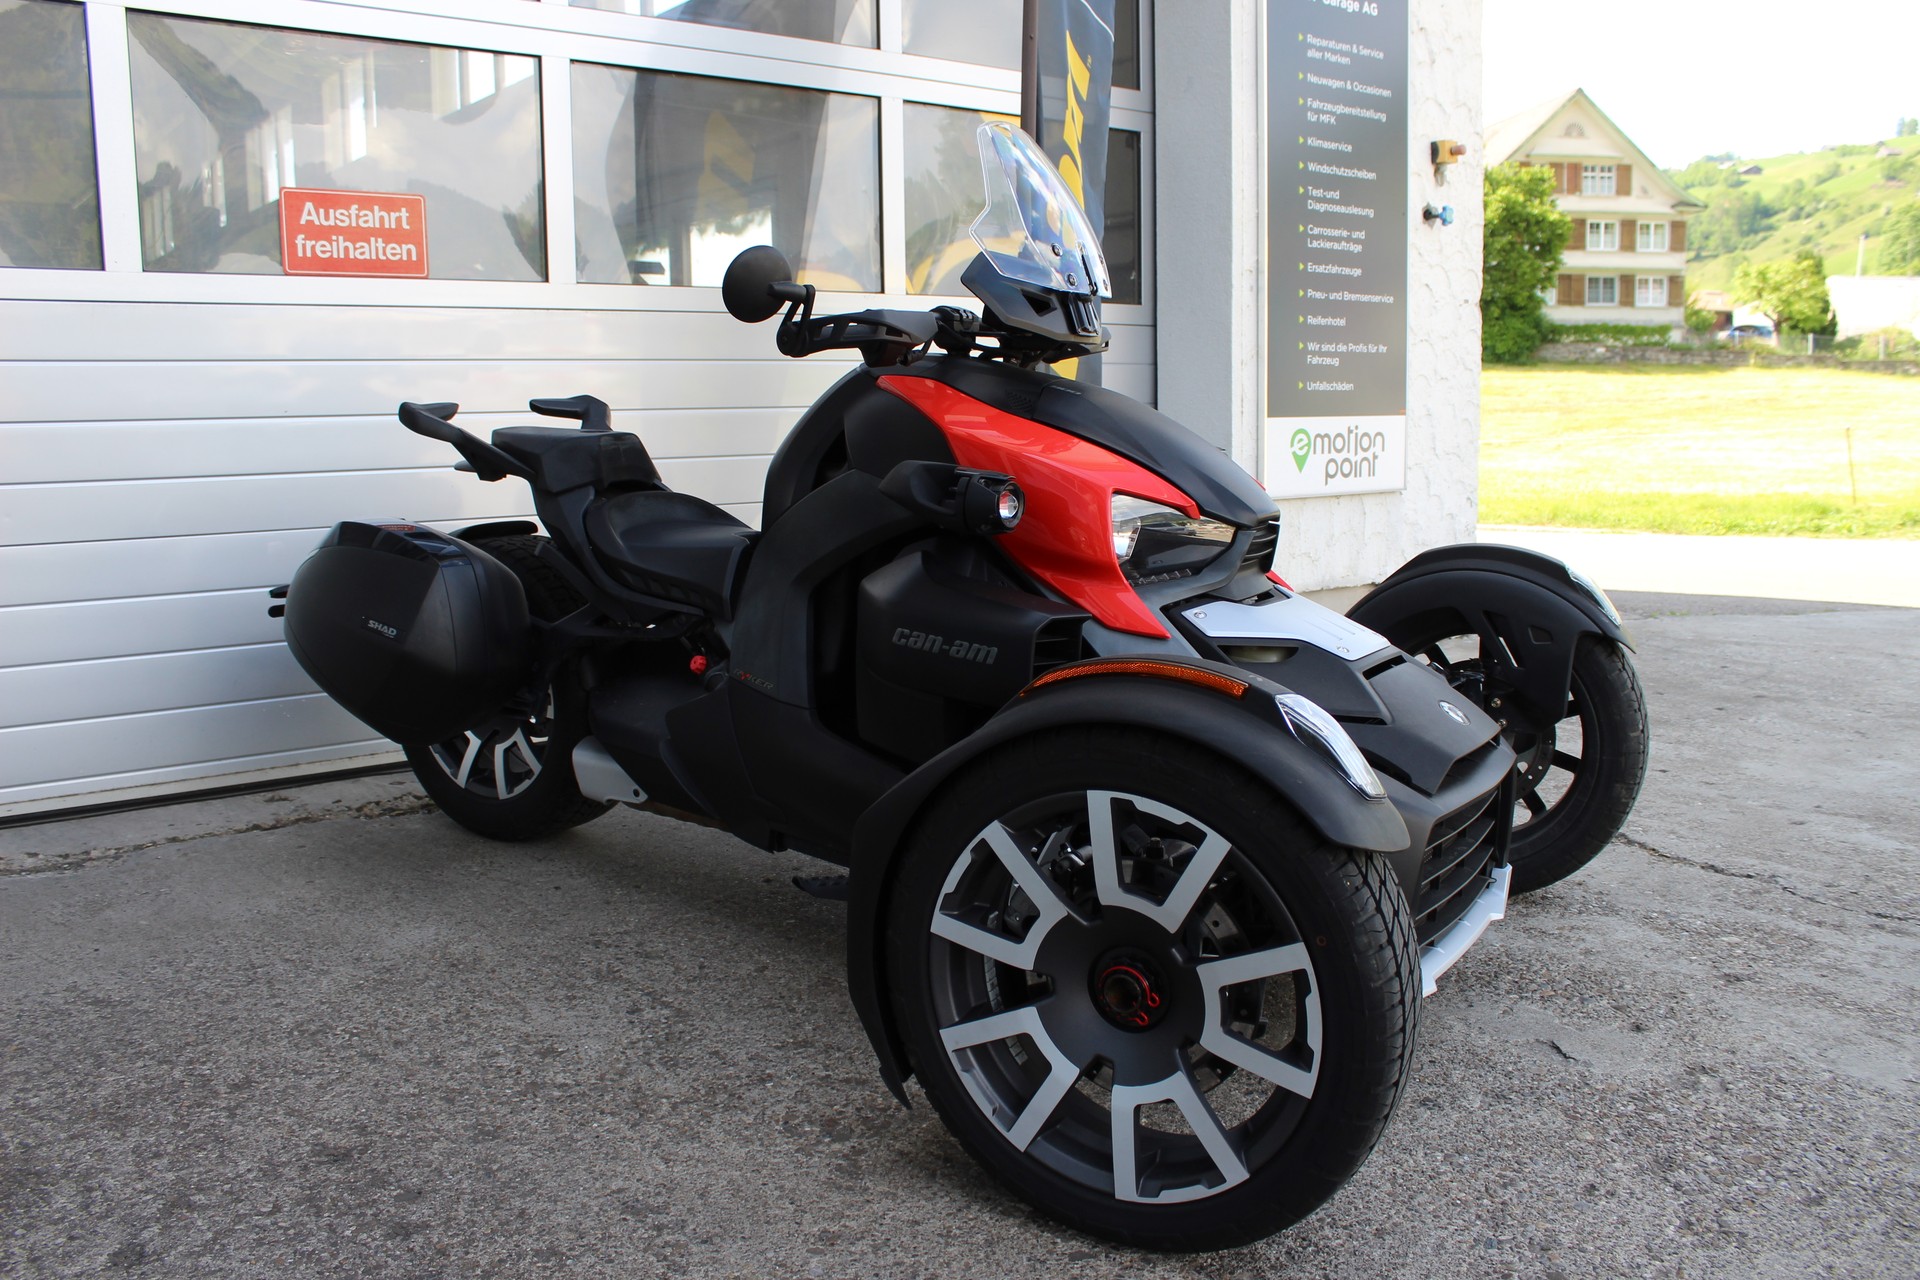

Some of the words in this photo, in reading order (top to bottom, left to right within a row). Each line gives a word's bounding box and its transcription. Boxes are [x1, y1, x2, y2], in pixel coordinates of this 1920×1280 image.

[1362, 1, 1378, 16] AG
[1307, 33, 1351, 53] Reparaturen
[1352, 44, 1358, 53] &
[1359, 45, 1384, 59] Service
[1307, 48, 1323, 59] aller
[1324, 51, 1351, 65] Marken
[1307, 73, 1346, 89] Neuwagen
[1346, 80, 1352, 90] &
[1353, 81, 1392, 98] Occasionen
[1307, 98, 1387, 122] Fahrzeugbereitstellung
[1307, 111, 1318, 122] für
[1319, 114, 1336, 125] MFK
[1307, 137, 1352, 152] Klimaservice
[1307, 161, 1377, 180] Windschutzscheiben
[300, 201, 410, 229] Ausfahrt
[1307, 200, 1375, 218] Diagnoseauslesung
[1307, 225, 1350, 238] Carrosserie-
[1352, 230, 1365, 239] und
[295, 234, 417, 261] freihalten
[1307, 238, 1363, 253] Lackieraufträge
[1307, 263, 1362, 277] Ersatzfahrzeuge
[1307, 289, 1328, 299] Pneu-
[1329, 291, 1343, 301] und
[1343, 291, 1394, 304] Bremsenservice
[1307, 315, 1346, 326] Reifenhotel
[1307, 342, 1319, 352] Wir
[1321, 342, 1336, 352] sind
[1336, 343, 1347, 352] die
[1348, 343, 1367, 353] Profis
[1368, 344, 1378, 353] für
[1378, 344, 1388, 353] Ihr
[1307, 355, 1340, 367] Fahrzeug
[1306, 381, 1354, 391] Unfallschäden
[1325, 452, 1379, 486] point
[367, 620, 398, 636] SHAD
[892, 627, 998, 665] can-am
